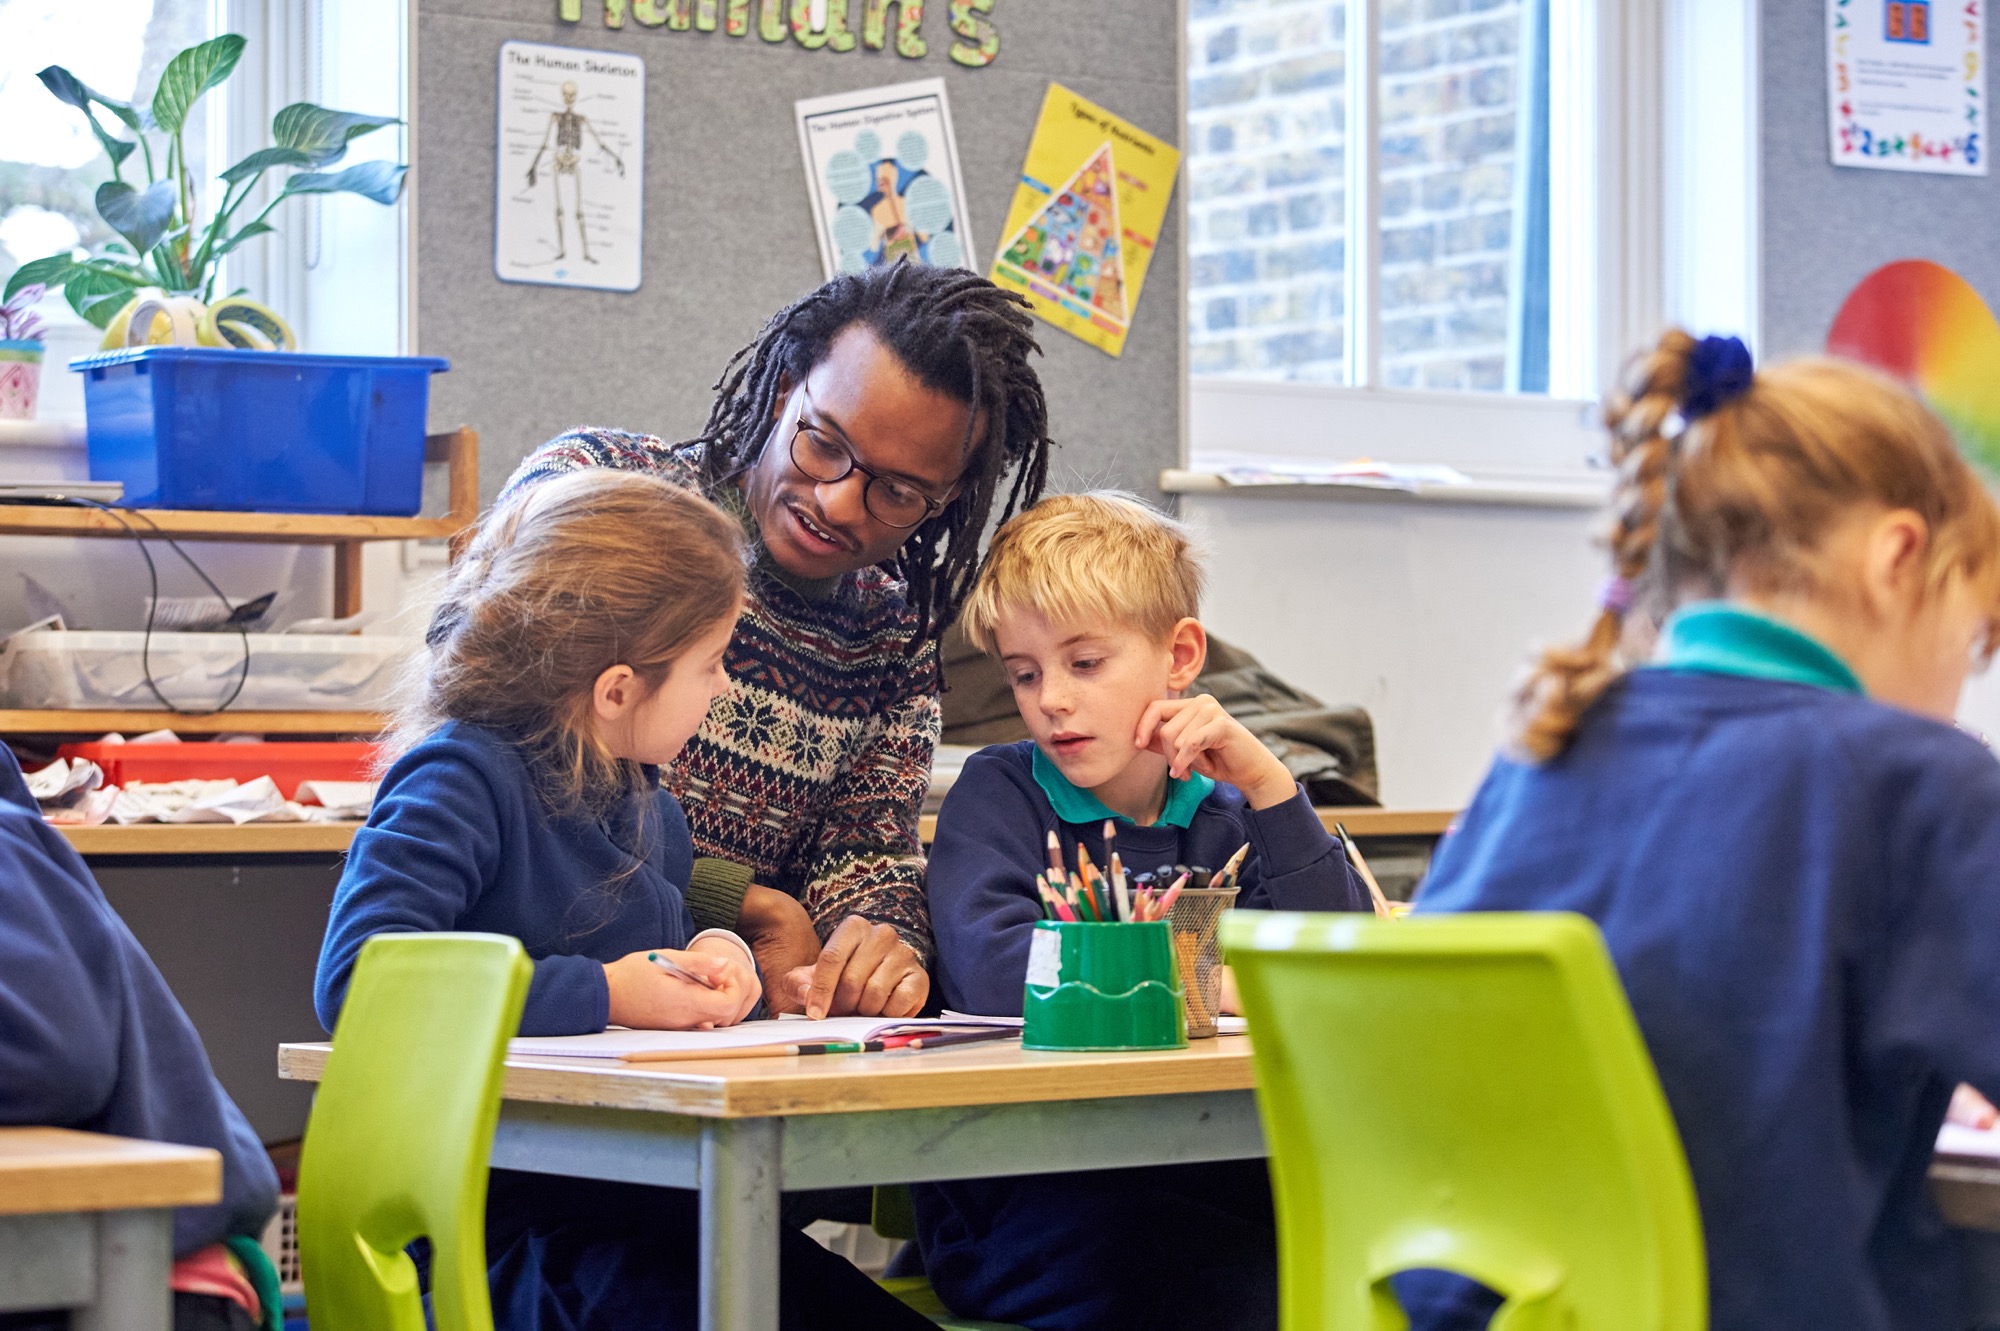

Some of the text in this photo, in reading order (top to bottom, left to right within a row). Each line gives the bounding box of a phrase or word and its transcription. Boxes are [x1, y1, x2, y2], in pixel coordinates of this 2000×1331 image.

[559, 0, 1000, 67] mans
[509, 51, 638, 77] The Human Skeleton
